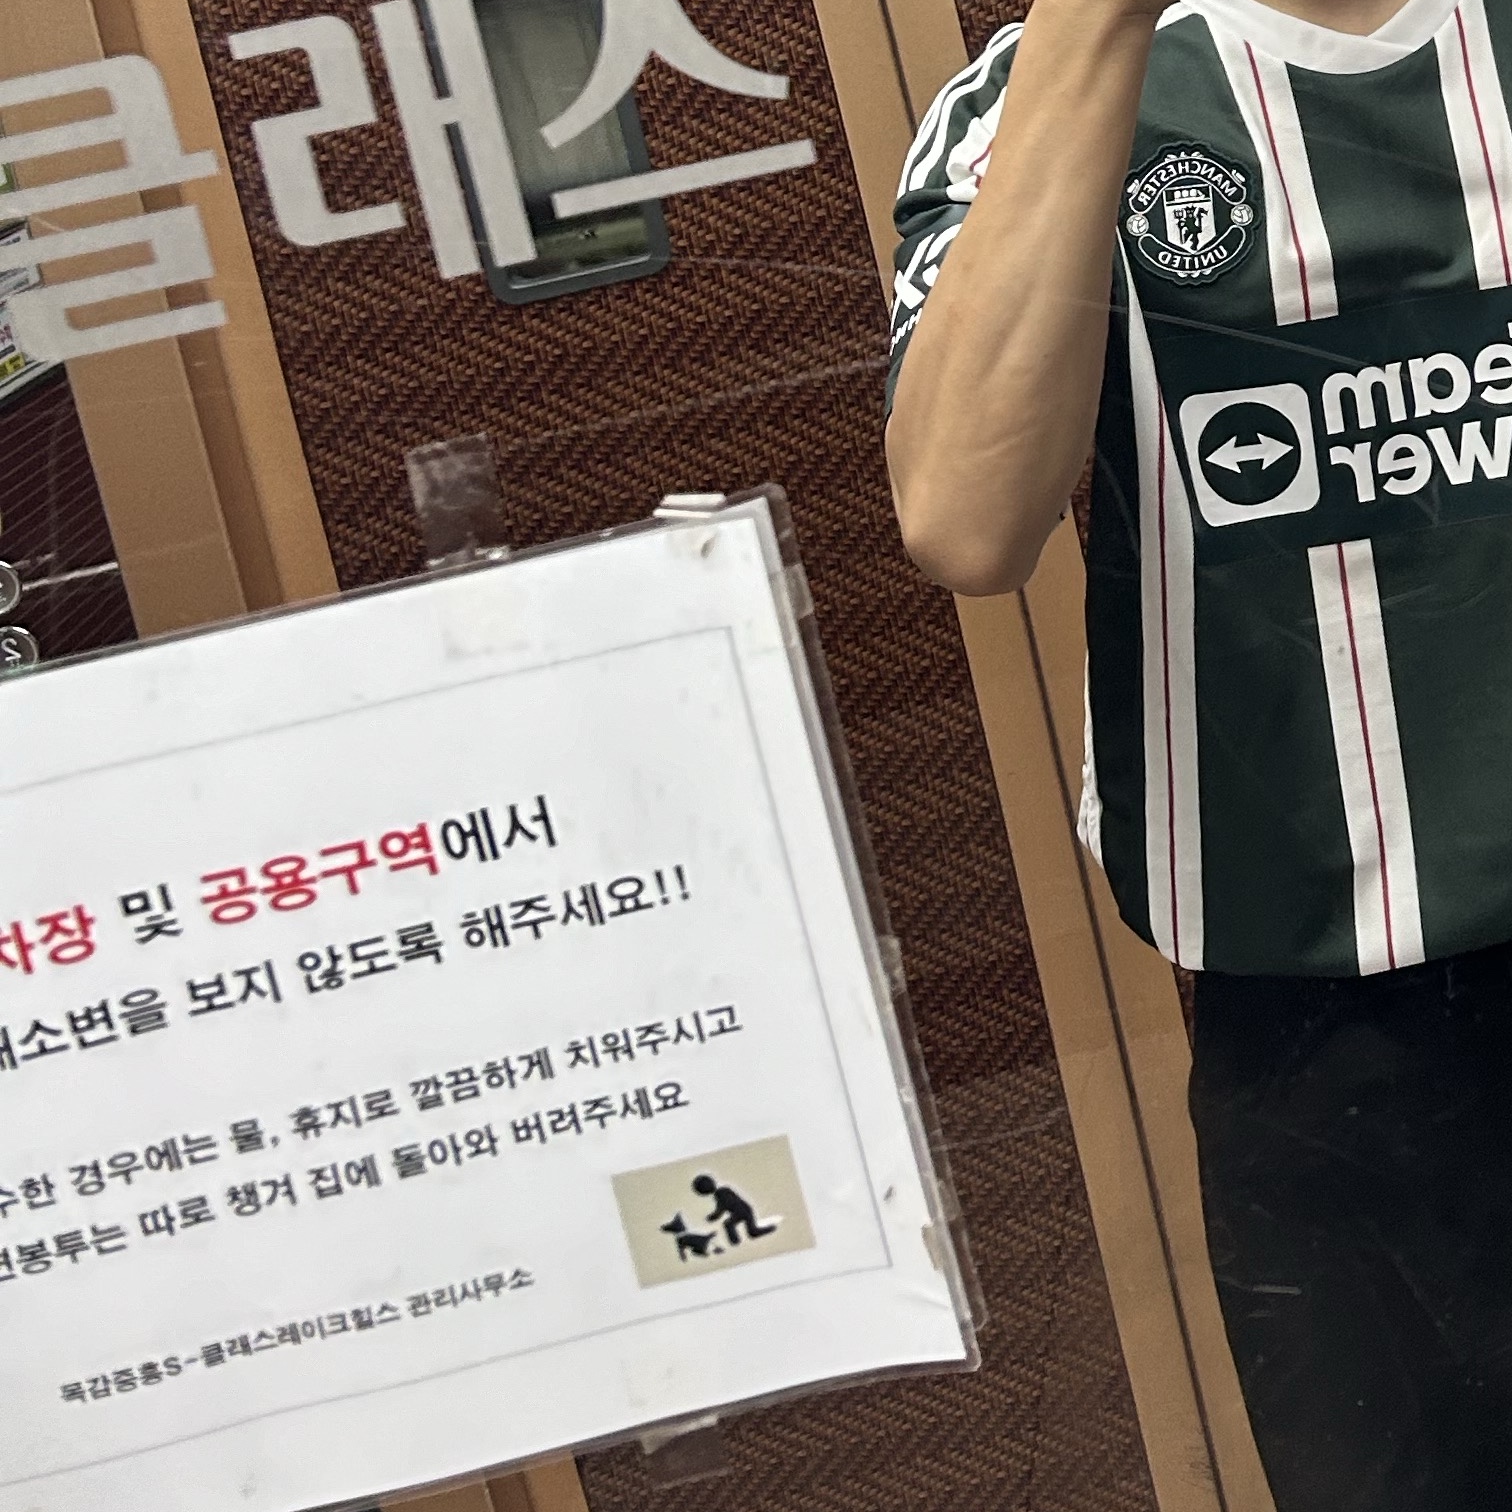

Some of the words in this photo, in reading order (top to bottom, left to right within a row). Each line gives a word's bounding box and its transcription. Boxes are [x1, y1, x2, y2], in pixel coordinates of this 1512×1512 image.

[117, 883, 184, 945] 및
[200, 794, 558, 926] 공용구역에서
[186, 959, 283, 1018] 보지
[296, 921, 444, 994] 않도록
[459, 864, 691, 949] 해주세요!!
[68, 1134, 220, 1197] 경우에는
[229, 1118, 281, 1155] 물,
[288, 1088, 401, 1141] 휴지로
[408, 1045, 557, 1113] 깔끔하게
[563, 1004, 744, 1070] 치워주시고
[137, 1195, 217, 1238] 따로
[226, 1173, 299, 1217] 챙겨
[306, 1153, 384, 1201] 집에
[392, 1124, 500, 1180] 돌아와
[512, 1080, 690, 1145] 버려주세요
[59, 1301, 402, 1404] 목감중흥S-클래스레이크힐스
[408, 1267, 536, 1318] 관리사무소
